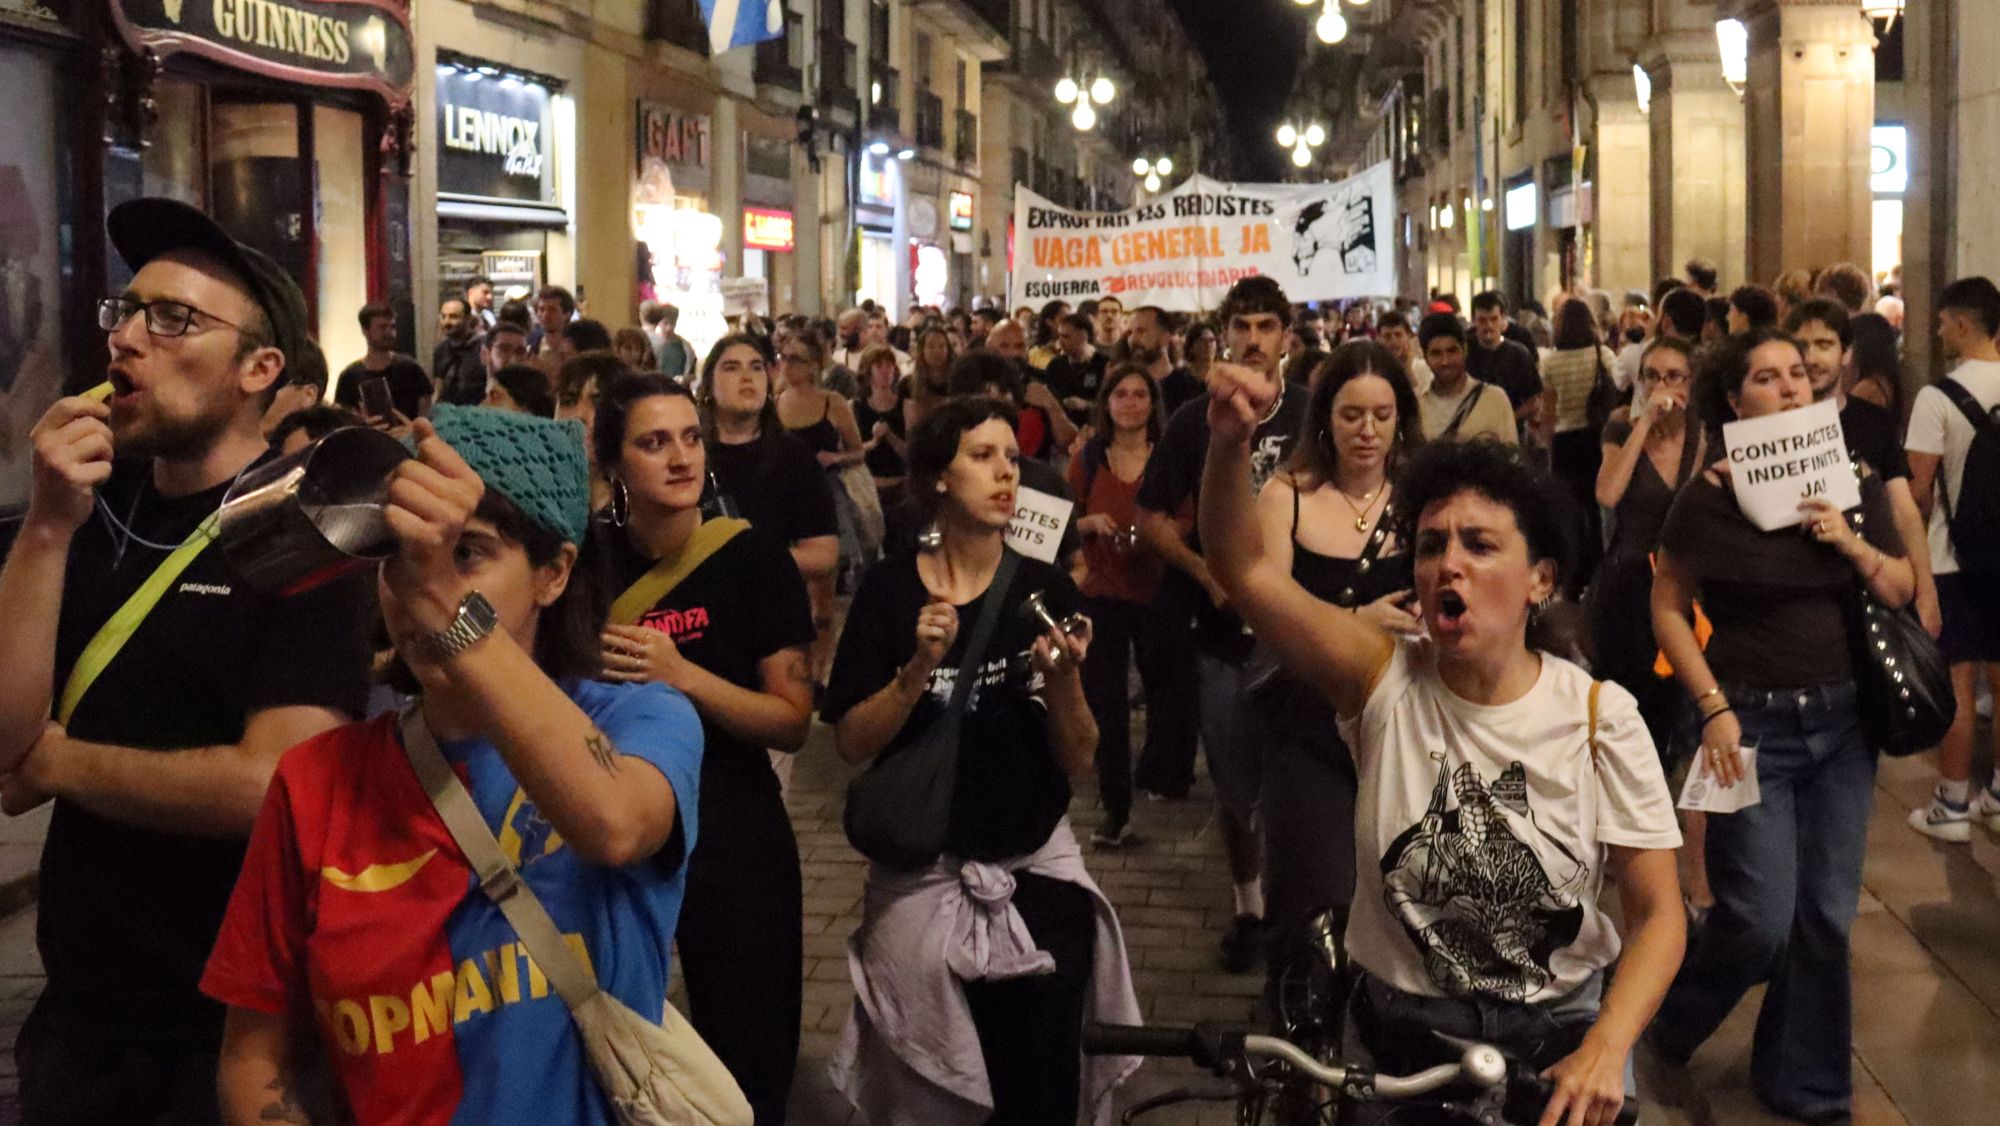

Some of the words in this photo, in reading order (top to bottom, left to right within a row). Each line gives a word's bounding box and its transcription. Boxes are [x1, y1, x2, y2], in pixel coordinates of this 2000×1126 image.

[212, 0, 349, 65] GUINNESS
[445, 103, 539, 157] LENNOX
[1032, 233, 1103, 269] VAGA
[1239, 222, 1271, 255] JA
[1025, 280, 1100, 298] ESQUERRA
[1731, 423, 1839, 463] CONTRACTES
[1747, 448, 1840, 485] INDEFINITS
[1801, 478, 1827, 498] JA!
[1013, 506, 1060, 530] CTES
[179, 582, 231, 596] patagonia
